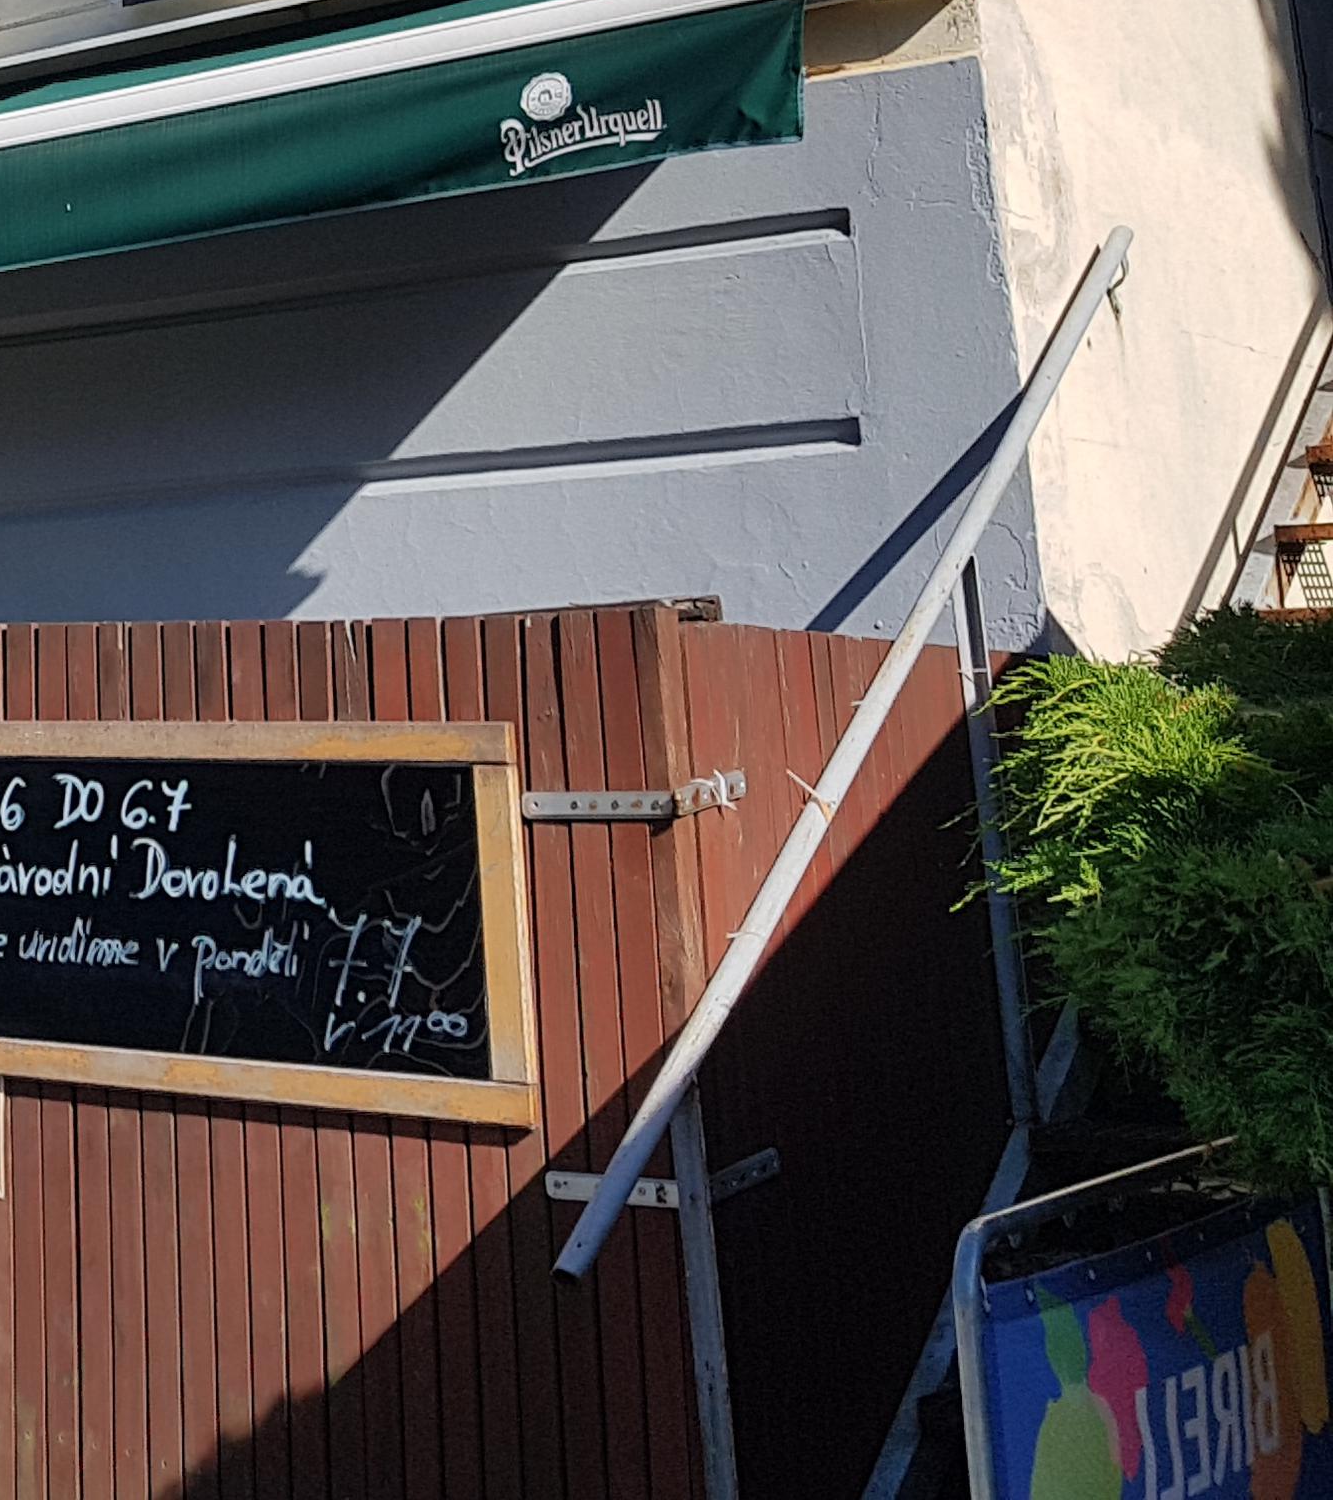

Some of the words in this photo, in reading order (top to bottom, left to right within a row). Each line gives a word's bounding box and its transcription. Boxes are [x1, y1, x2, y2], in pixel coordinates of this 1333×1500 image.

[500, 118, 583, 177] Pilsner
[576, 99, 665, 147] Urquell
[52, 772, 105, 829] DO
[121, 779, 193, 832] 6.7
[129, 832, 326, 908] Dovolená
